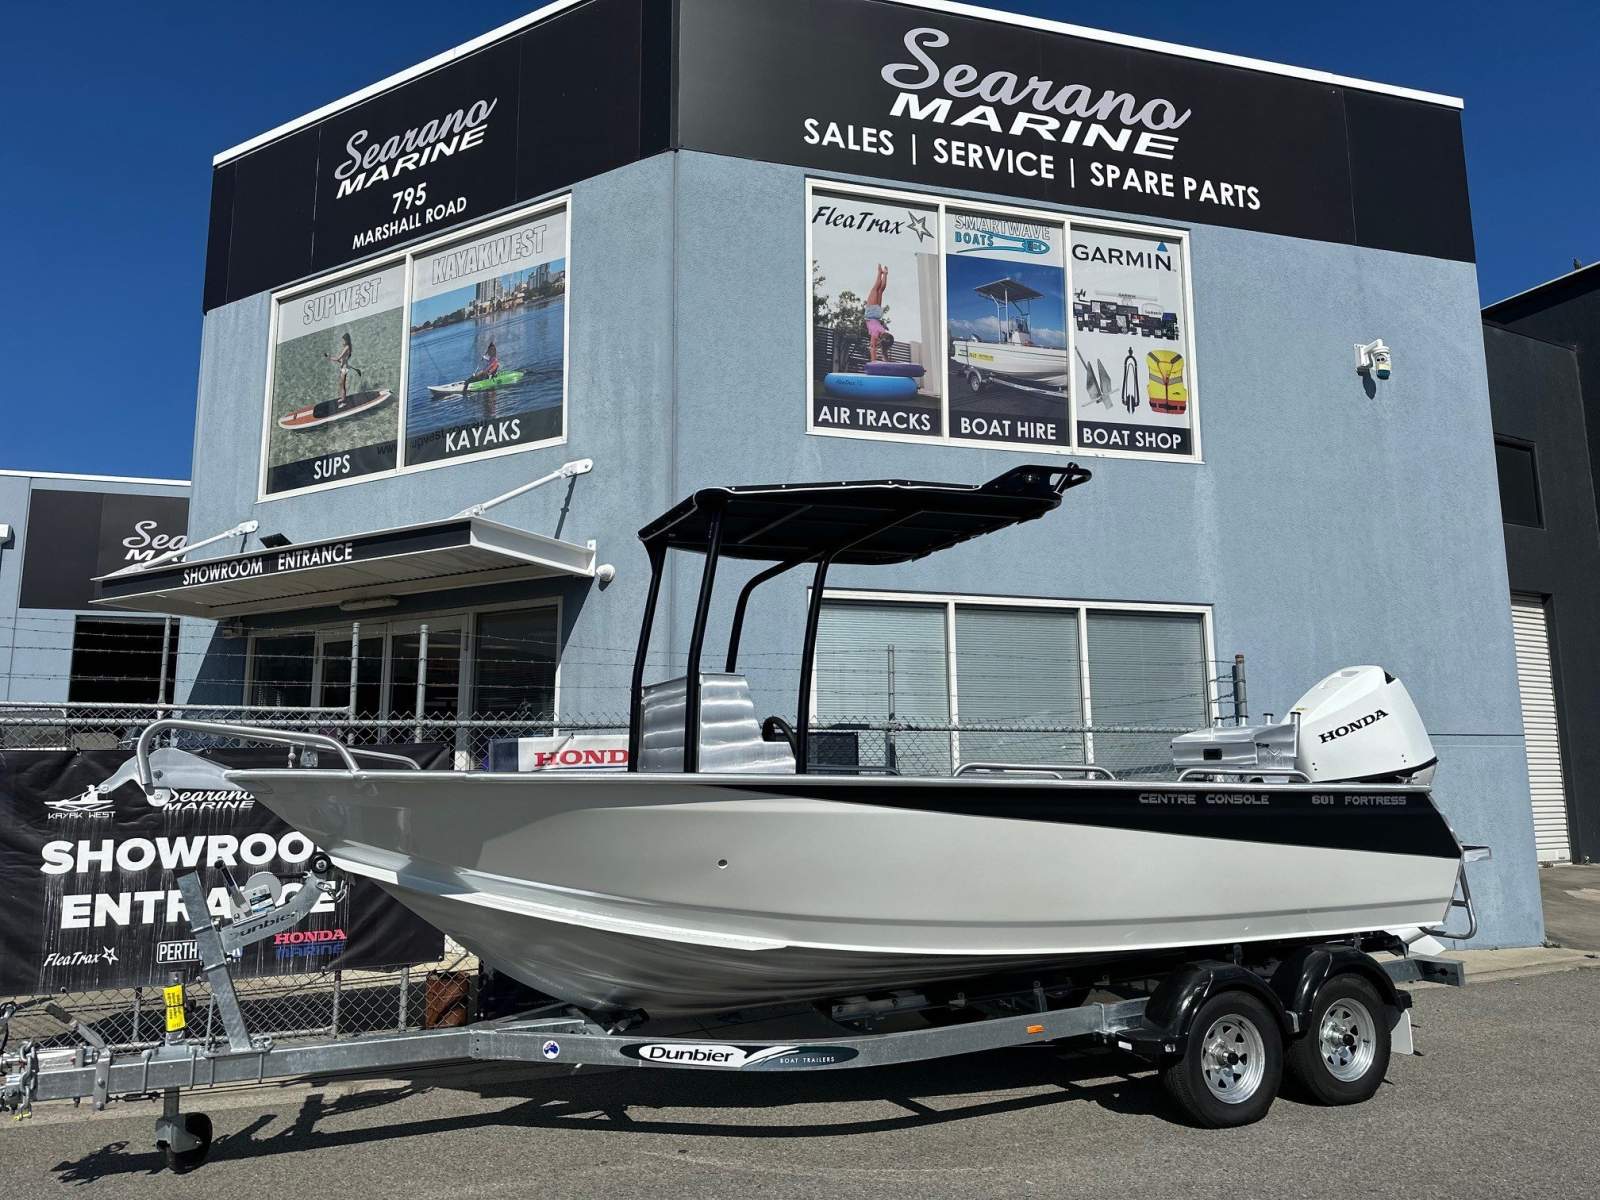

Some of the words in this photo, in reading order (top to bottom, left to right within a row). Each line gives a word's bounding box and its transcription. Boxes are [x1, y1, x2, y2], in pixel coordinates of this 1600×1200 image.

[880, 26, 1192, 131] Searano
[334, 97, 498, 180] Searano
[889, 91, 1180, 160] MARINE
[336, 123, 488, 200] MARINE
[803, 117, 895, 156] SALES
[933, 137, 1055, 180] SERVICE
[1090, 161, 1175, 198] SPARE
[1183, 176, 1262, 211] PARTS
[392, 182, 427, 214] 795
[352, 212, 422, 250] MARSHALL
[425, 196, 467, 224] ROAD
[812, 206, 904, 235] FleaTrax
[953, 213, 1051, 240] SMARTWAVE
[954, 231, 994, 247] BOATS
[432, 225, 547, 285] KAYAKWEST
[1072, 243, 1172, 272] GARMIN
[303, 277, 382, 325] SUPWEST
[818, 405, 850, 424] AIR
[856, 408, 931, 431] TRACKS
[960, 416, 1014, 437] BOAT
[1017, 421, 1057, 440] HIRE
[445, 419, 521, 453] KAYAKS
[1083, 428, 1130, 446] BOAT
[1135, 431, 1182, 449] SHOP
[313, 455, 350, 480] SUPS
[182, 557, 263, 586] SHOWROOM
[277, 542, 353, 571] ENTRANCE
[1318, 709, 1389, 744] HONDA
[534, 749, 630, 768] HOND
[163, 800, 256, 811] MARINE
[1139, 793, 1197, 805] CENTRE
[1205, 794, 1270, 805] CONSOLE
[1344, 795, 1407, 806] FORTRESS
[47, 811, 83, 820] KAYAK
[88, 810, 117, 819] WEST
[40, 831, 325, 875] SHOWROO
[159, 941, 198, 961] PERTH
[274, 928, 348, 945] HONDA
[43, 951, 102, 967] FleaTrax
[649, 1045, 734, 1064] Dunbier
